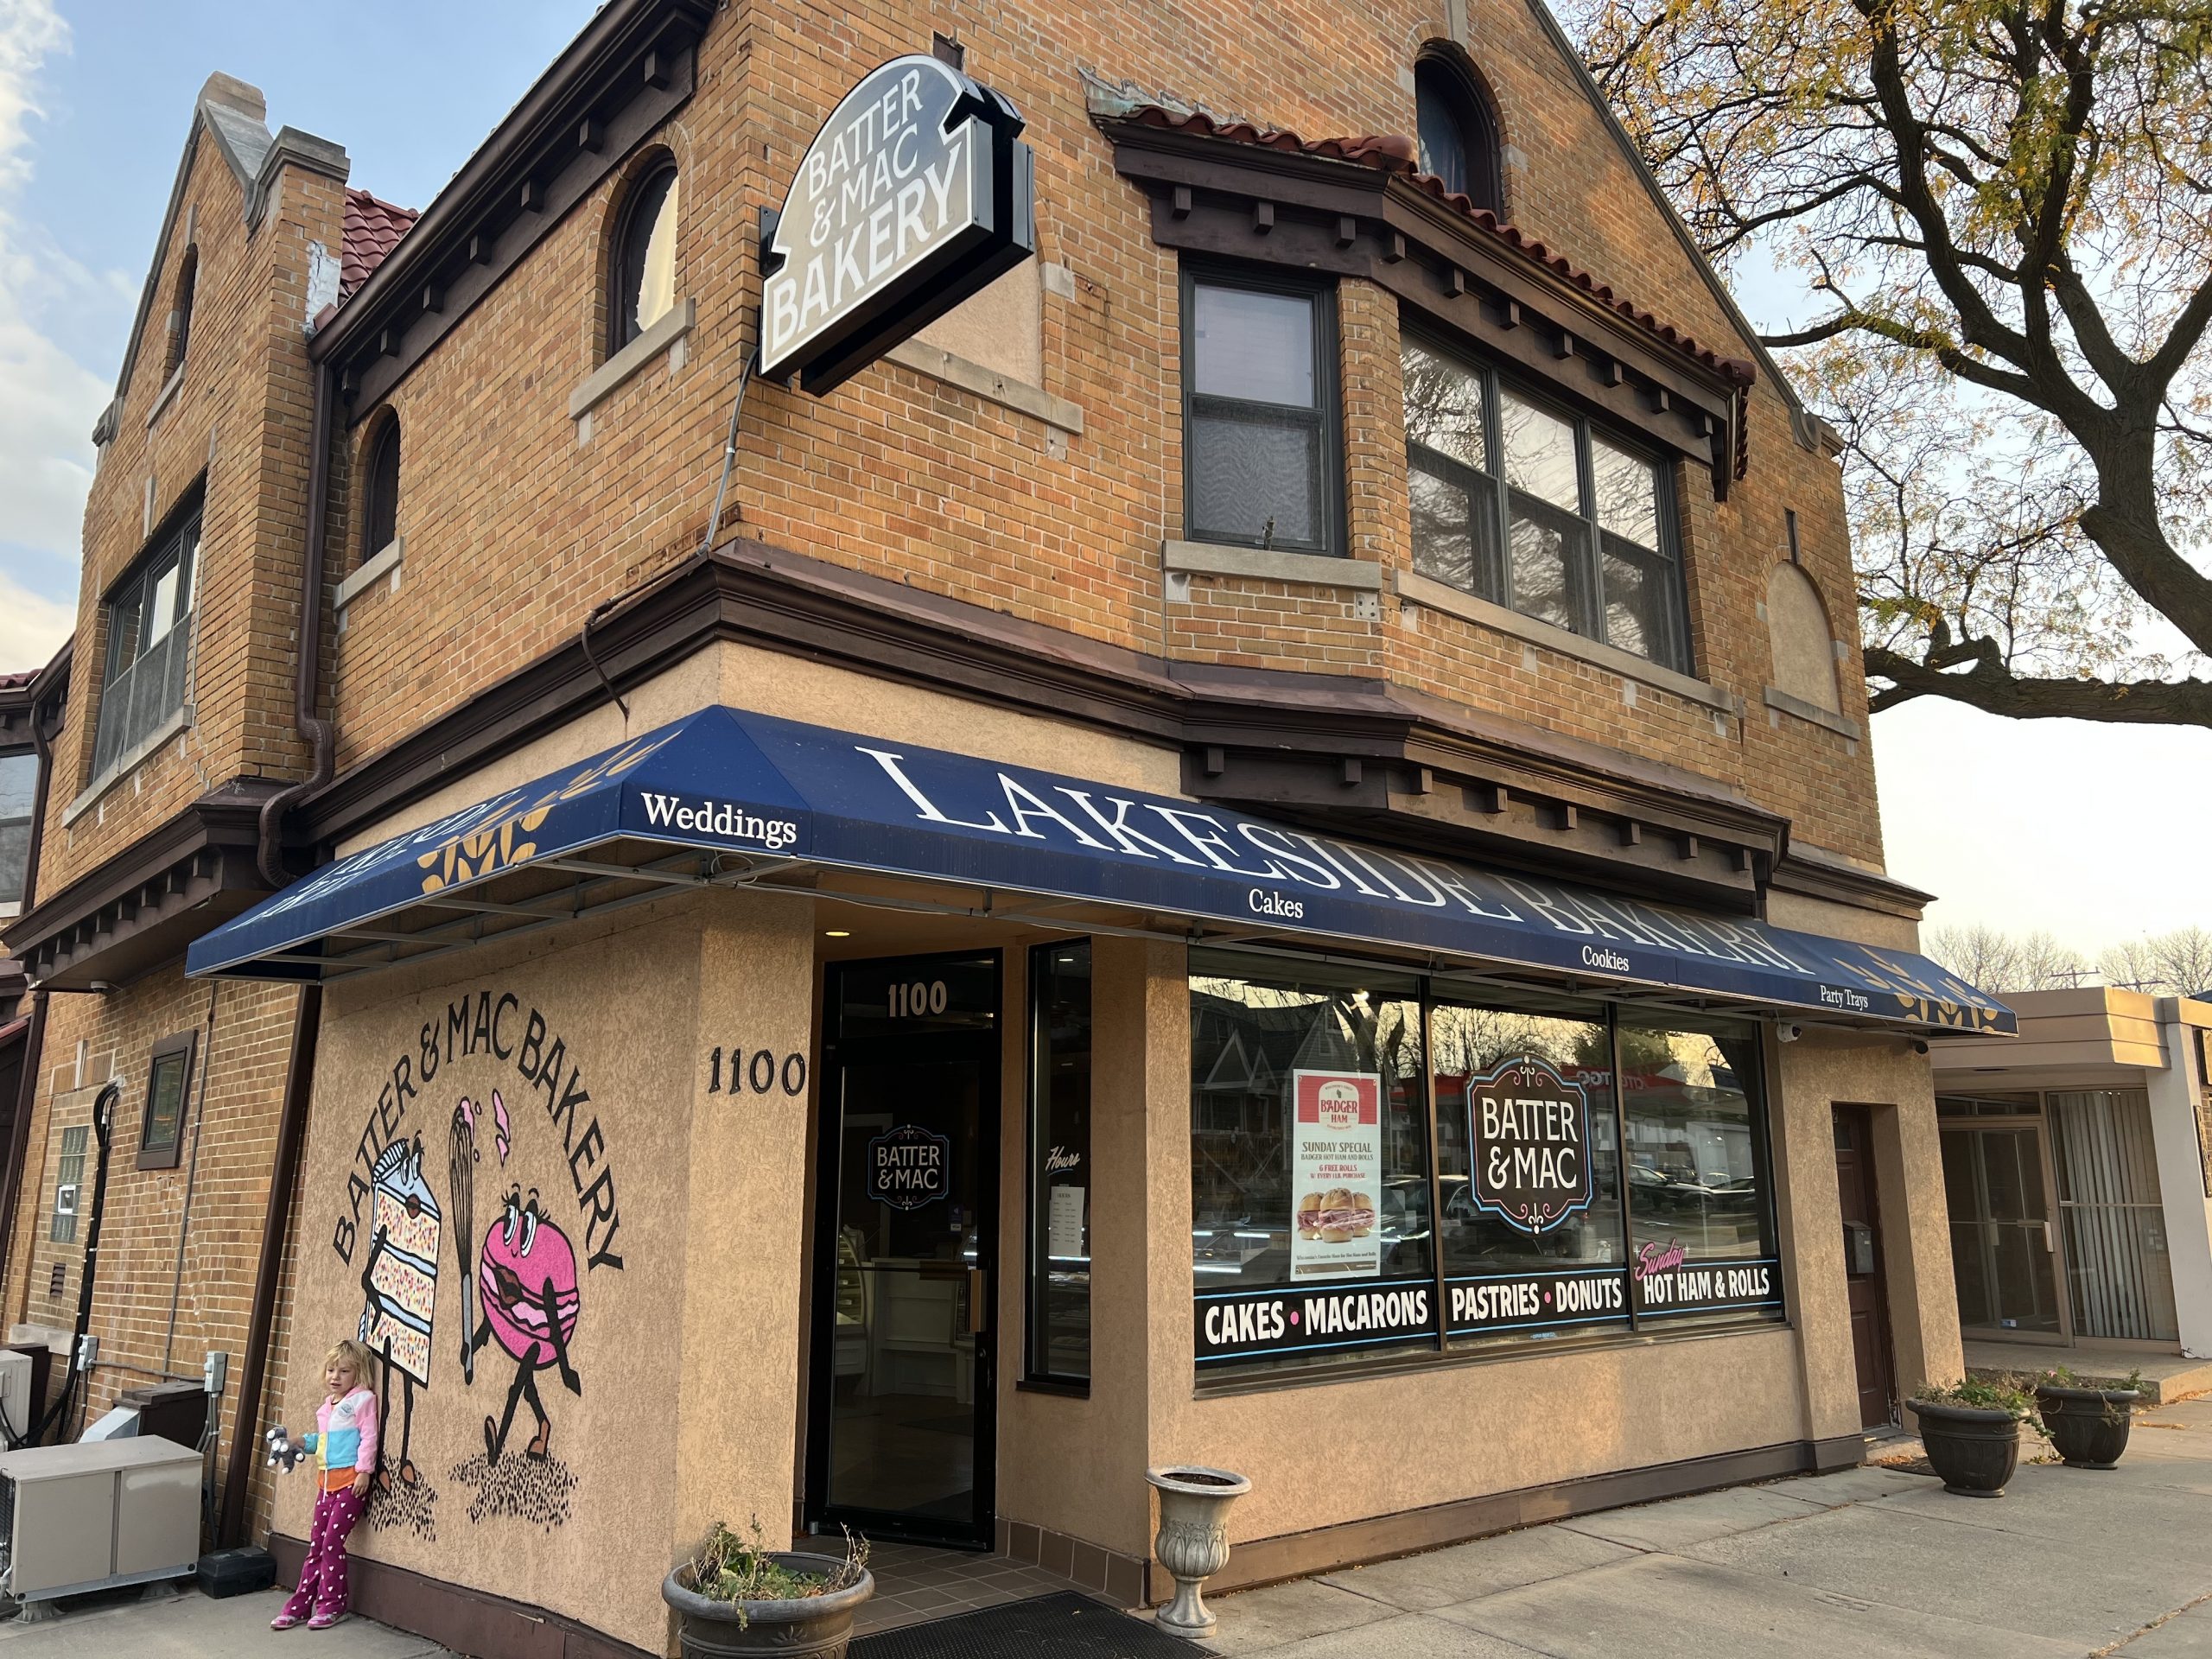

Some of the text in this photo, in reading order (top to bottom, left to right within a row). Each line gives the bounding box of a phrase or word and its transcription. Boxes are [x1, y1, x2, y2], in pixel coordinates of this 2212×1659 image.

[809, 68, 923, 201] BATTER
[810, 123, 918, 247] & MAC
[772, 141, 963, 353] BAKERY
[640, 792, 798, 848] Weddings
[855, 747, 1815, 975] LAKESIDE BAKERY
[1249, 888, 1304, 918] Cakes
[1582, 945, 1629, 972] Cookies
[888, 980, 947, 1017] 1100
[1820, 985, 1868, 1010] Party Trays
[709, 1046, 805, 1096] 1100
[1320, 1099, 1357, 1113] BADGER
[1331, 1114, 1348, 1122] HAM
[1481, 1097, 1579, 1142] BATTER
[333, 991, 624, 1274] BATTER & MAC BAKERY
[1302, 1141, 1372, 1153] SUNDAY SPECIAL
[877, 1146, 940, 1166] BATTER
[1046, 1146, 1080, 1171] Hours
[1488, 1146, 1577, 1190] & MAC
[878, 1168, 938, 1189] & MAC
[1635, 1237, 1685, 1281] Sunday
[1452, 1277, 1622, 1321] PASTRIES DONUTS
[1643, 1268, 1770, 1305] HOT HAM & ROLLS
[1205, 1290, 1427, 1344] CAKES MACARONS
